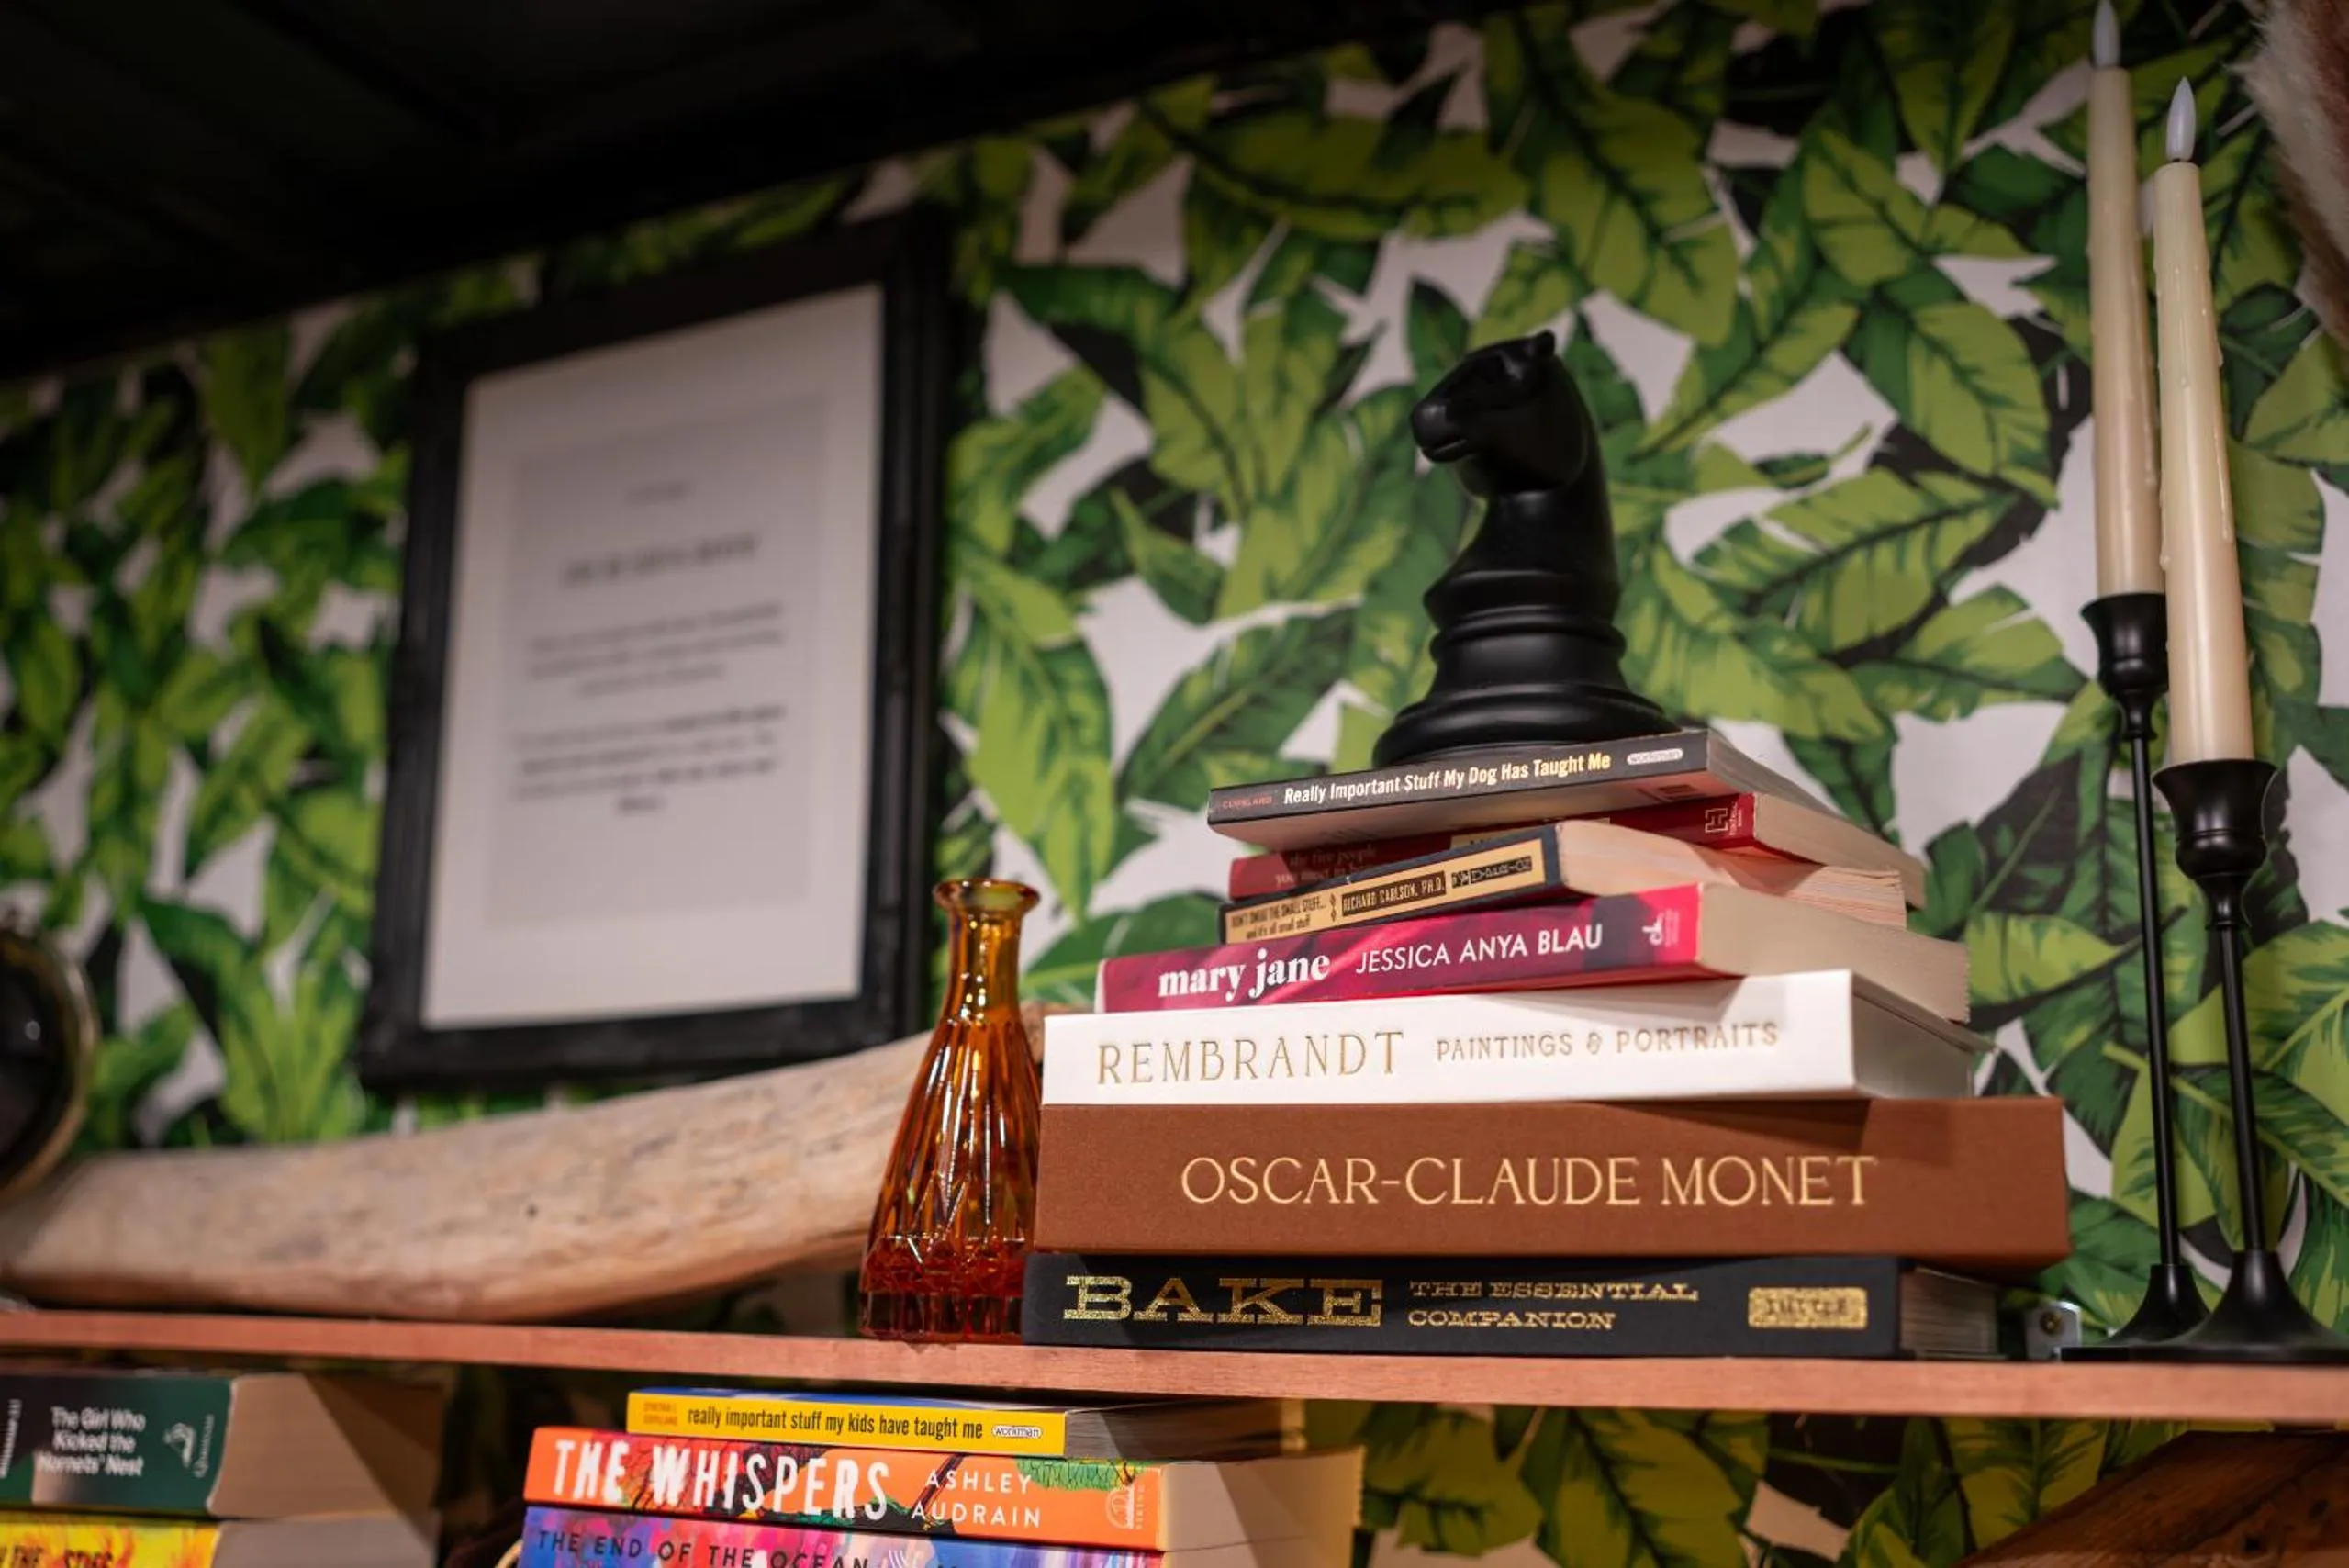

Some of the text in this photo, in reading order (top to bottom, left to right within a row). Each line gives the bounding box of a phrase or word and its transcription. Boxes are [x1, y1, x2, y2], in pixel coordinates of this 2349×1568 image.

[1284, 753, 1611, 806] Really Important Stuff My Dog Has Taught Me
[1343, 892, 1377, 912] RICHARD
[1356, 924, 1603, 975] JESSICA ANYA BLAU
[1158, 948, 1331, 1002] mary jane
[1098, 1029, 1404, 1085] REMBRANDT
[1437, 1032, 1573, 1062] PAINTINGS
[1616, 1021, 1779, 1054] PORTRAITS
[1181, 1155, 1879, 1206] OSCAR-CLAUDE MONET
[1063, 1275, 1383, 1327] BAKE
[1408, 1281, 1699, 1302] THE ESSENTIAL
[1407, 1309, 1616, 1329] COMPANION
[50, 1406, 146, 1432] The Girl Who
[688, 1406, 721, 1428] really
[726, 1409, 787, 1431] important
[790, 1411, 822, 1430] stuff
[826, 1417, 843, 1435] my
[848, 1413, 875, 1433] kids
[879, 1415, 909, 1435] have
[914, 1417, 957, 1439] taught
[962, 1421, 983, 1439] me
[995, 1425, 1040, 1438] workman
[53, 1429, 136, 1454] Kicked the
[106, 1457, 145, 1477] Nest
[554, 1439, 890, 1521] THE WHISPERS
[925, 1470, 1031, 1495] ASHLEY
[912, 1501, 1042, 1529] AUDRAIN
[538, 1530, 580, 1552] THE
[594, 1535, 642, 1558] END
[658, 1540, 691, 1561] OF
[709, 1544, 755, 1568] THE
